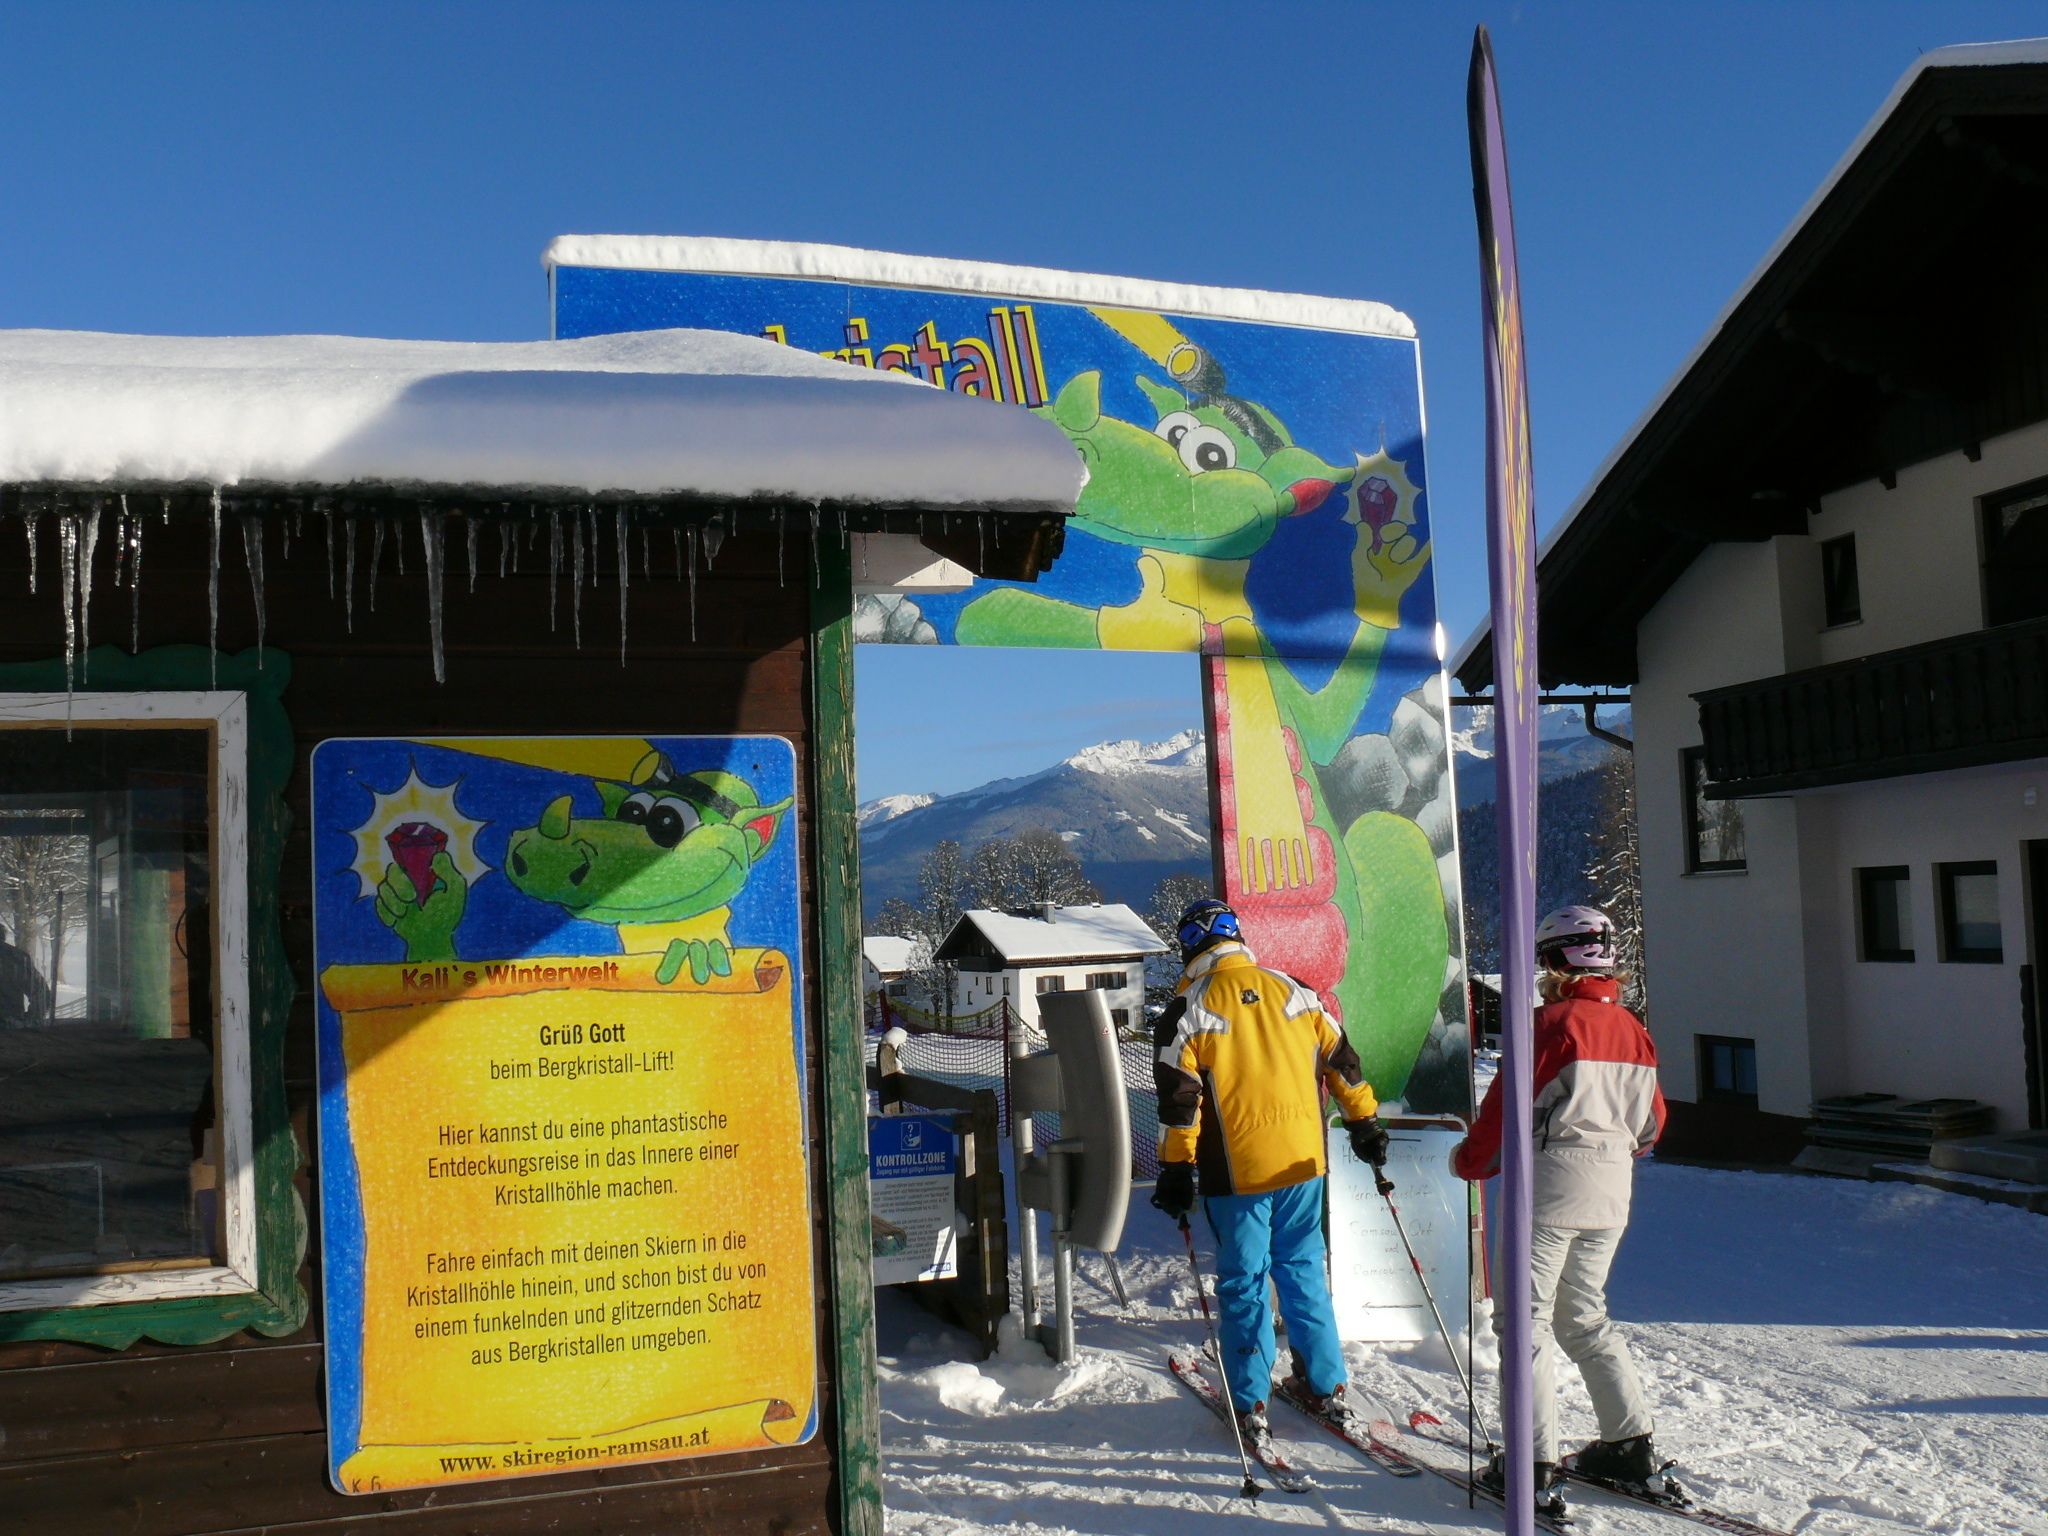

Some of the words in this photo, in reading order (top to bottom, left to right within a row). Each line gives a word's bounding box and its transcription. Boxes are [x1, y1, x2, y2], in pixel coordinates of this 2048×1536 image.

[485, 961, 620, 985] Winterwelt
[539, 1024, 583, 1046] Grüß
[589, 1023, 626, 1044] Gott
[490, 1058, 532, 1080] beim
[538, 1050, 675, 1080] Bergkristall-Lift!
[439, 1124, 474, 1146] Hier
[480, 1121, 538, 1144] kannst
[543, 1119, 563, 1140] du
[570, 1117, 605, 1139] eine
[611, 1110, 728, 1140] phantastische
[428, 1150, 579, 1179] Entdeckungsreise
[585, 1149, 600, 1169] in
[606, 1147, 636, 1167] das
[642, 1144, 693, 1165] Innere
[699, 1141, 740, 1161] einer
[876, 1151, 947, 1167] KONTROLLZONE
[495, 1179, 601, 1206] Kristallhöhle
[607, 1175, 678, 1198] machen.
[427, 1251, 475, 1274] Fahre
[481, 1246, 544, 1270] einfach
[551, 1242, 578, 1264] mit
[583, 1240, 639, 1262] deinen
[645, 1235, 696, 1257] Skiern
[702, 1232, 717, 1252] in
[722, 1231, 747, 1251] die
[407, 1278, 515, 1307] Kristallhöhle
[521, 1276, 579, 1298] hinein,
[585, 1271, 615, 1293] und
[622, 1268, 671, 1290] schon
[677, 1264, 707, 1285] bist
[712, 1262, 732, 1282] du
[738, 1262, 767, 1279] von
[415, 1318, 467, 1339] einem
[473, 1307, 568, 1333] funkelnden
[575, 1303, 605, 1325] und
[611, 1295, 702, 1326] glitzernden
[707, 1291, 762, 1313] Schatz
[471, 1346, 502, 1365] aus
[509, 1332, 625, 1363] Bergkristallen
[631, 1325, 712, 1352] umgeben.
[439, 1454, 497, 1474] www.
[502, 1426, 711, 1469] skiregion-ramsau.at
